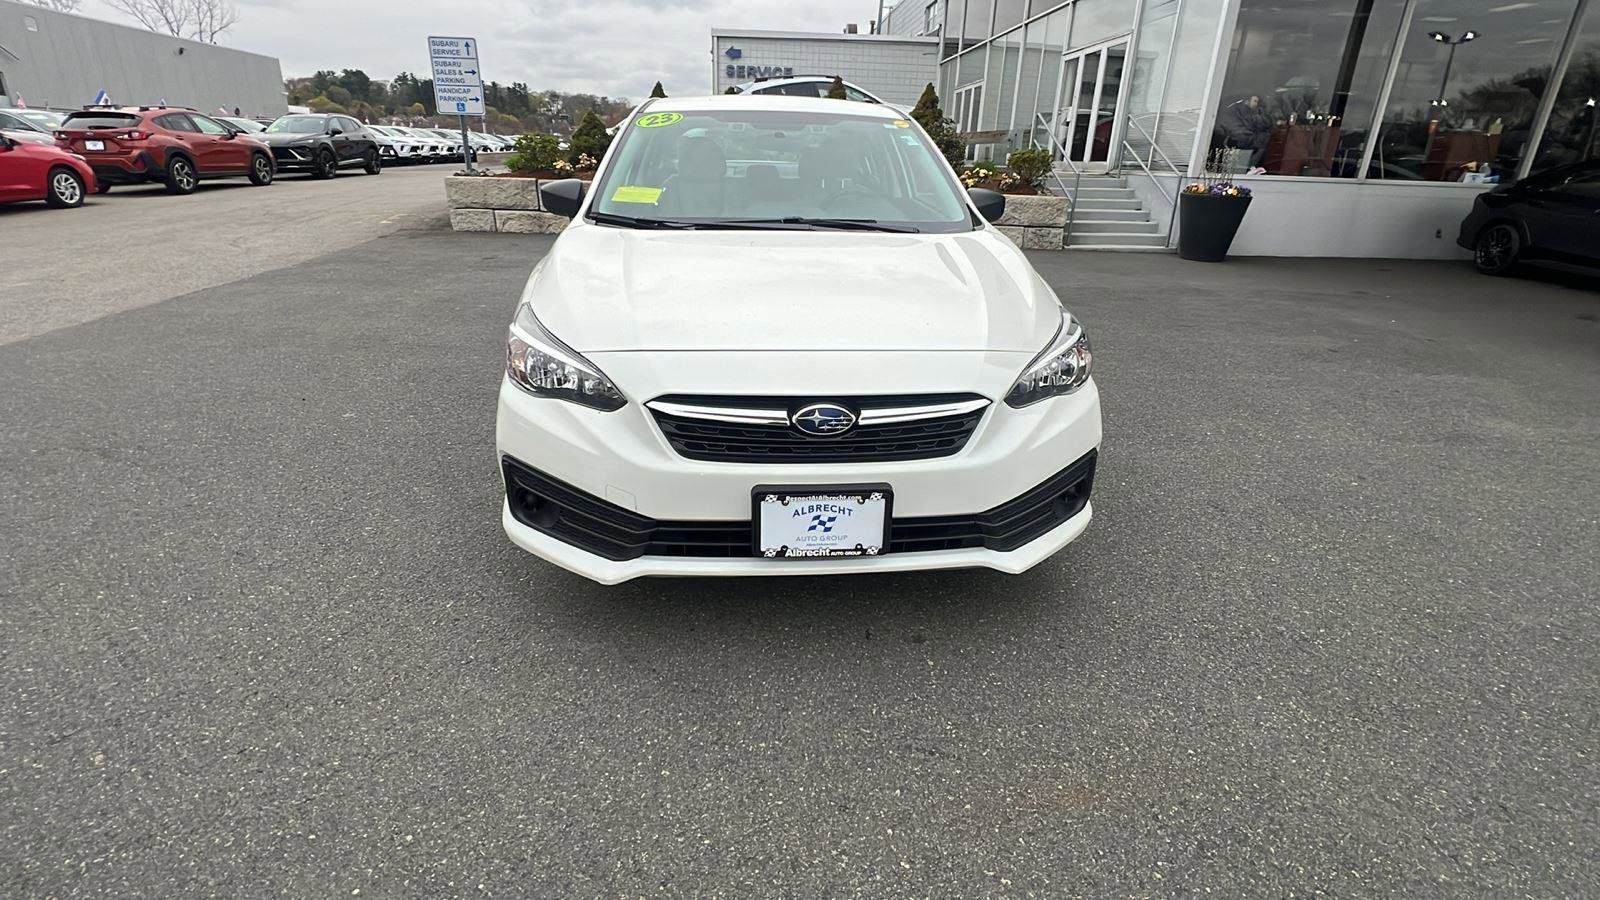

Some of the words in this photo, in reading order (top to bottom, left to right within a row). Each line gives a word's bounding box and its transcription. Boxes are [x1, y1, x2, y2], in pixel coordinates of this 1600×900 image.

[432, 48, 461, 56] SERVICE
[726, 64, 793, 79] SERVICE
[646, 113, 674, 126] 23
[792, 504, 853, 518] ALBRECHT
[784, 547, 831, 558] Albrecht
